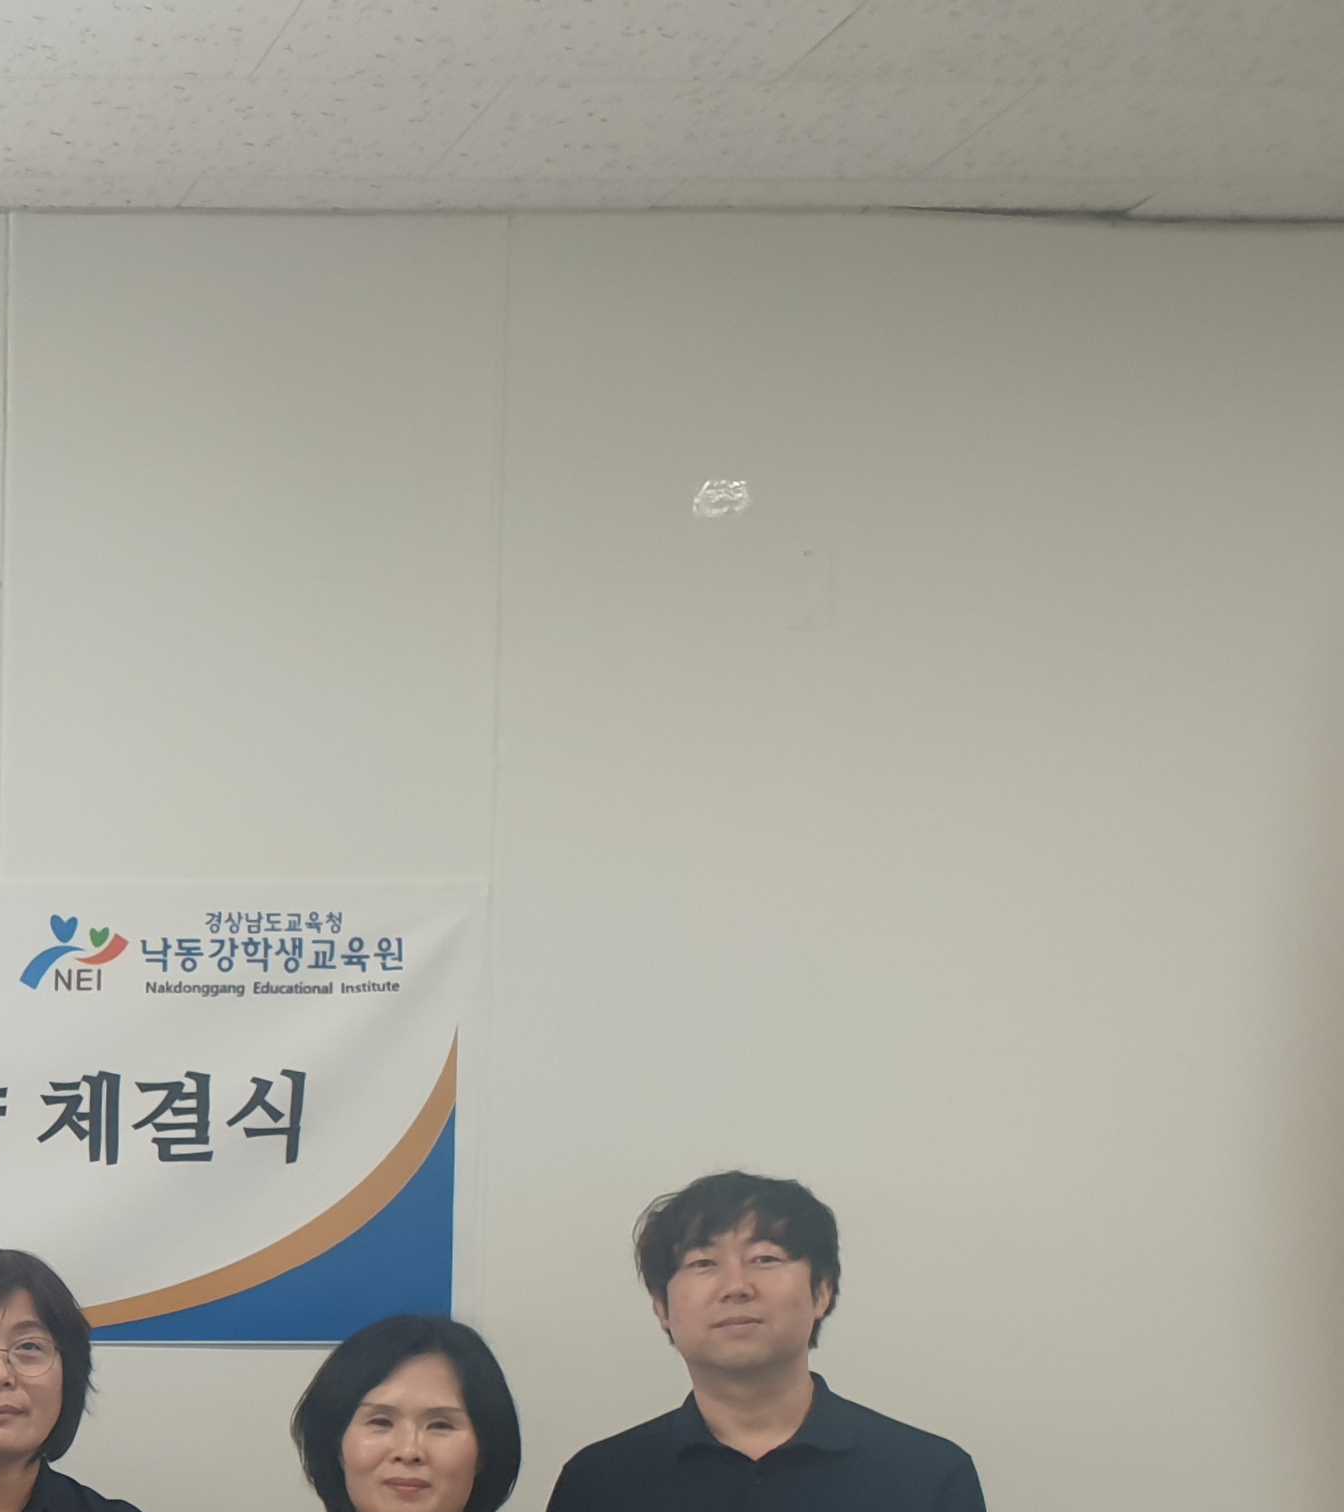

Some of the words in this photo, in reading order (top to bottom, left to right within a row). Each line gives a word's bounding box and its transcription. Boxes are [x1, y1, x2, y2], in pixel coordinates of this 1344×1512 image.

[205, 911, 343, 934] 경상남도교육청
[140, 936, 404, 974] 낙동강학생교육원
[54, 968, 102, 992] NEI
[145, 980, 246, 998] Nakdonggang
[252, 980, 334, 995] Educational
[340, 980, 400, 995] Institute
[36, 1068, 307, 1166] 체결식
